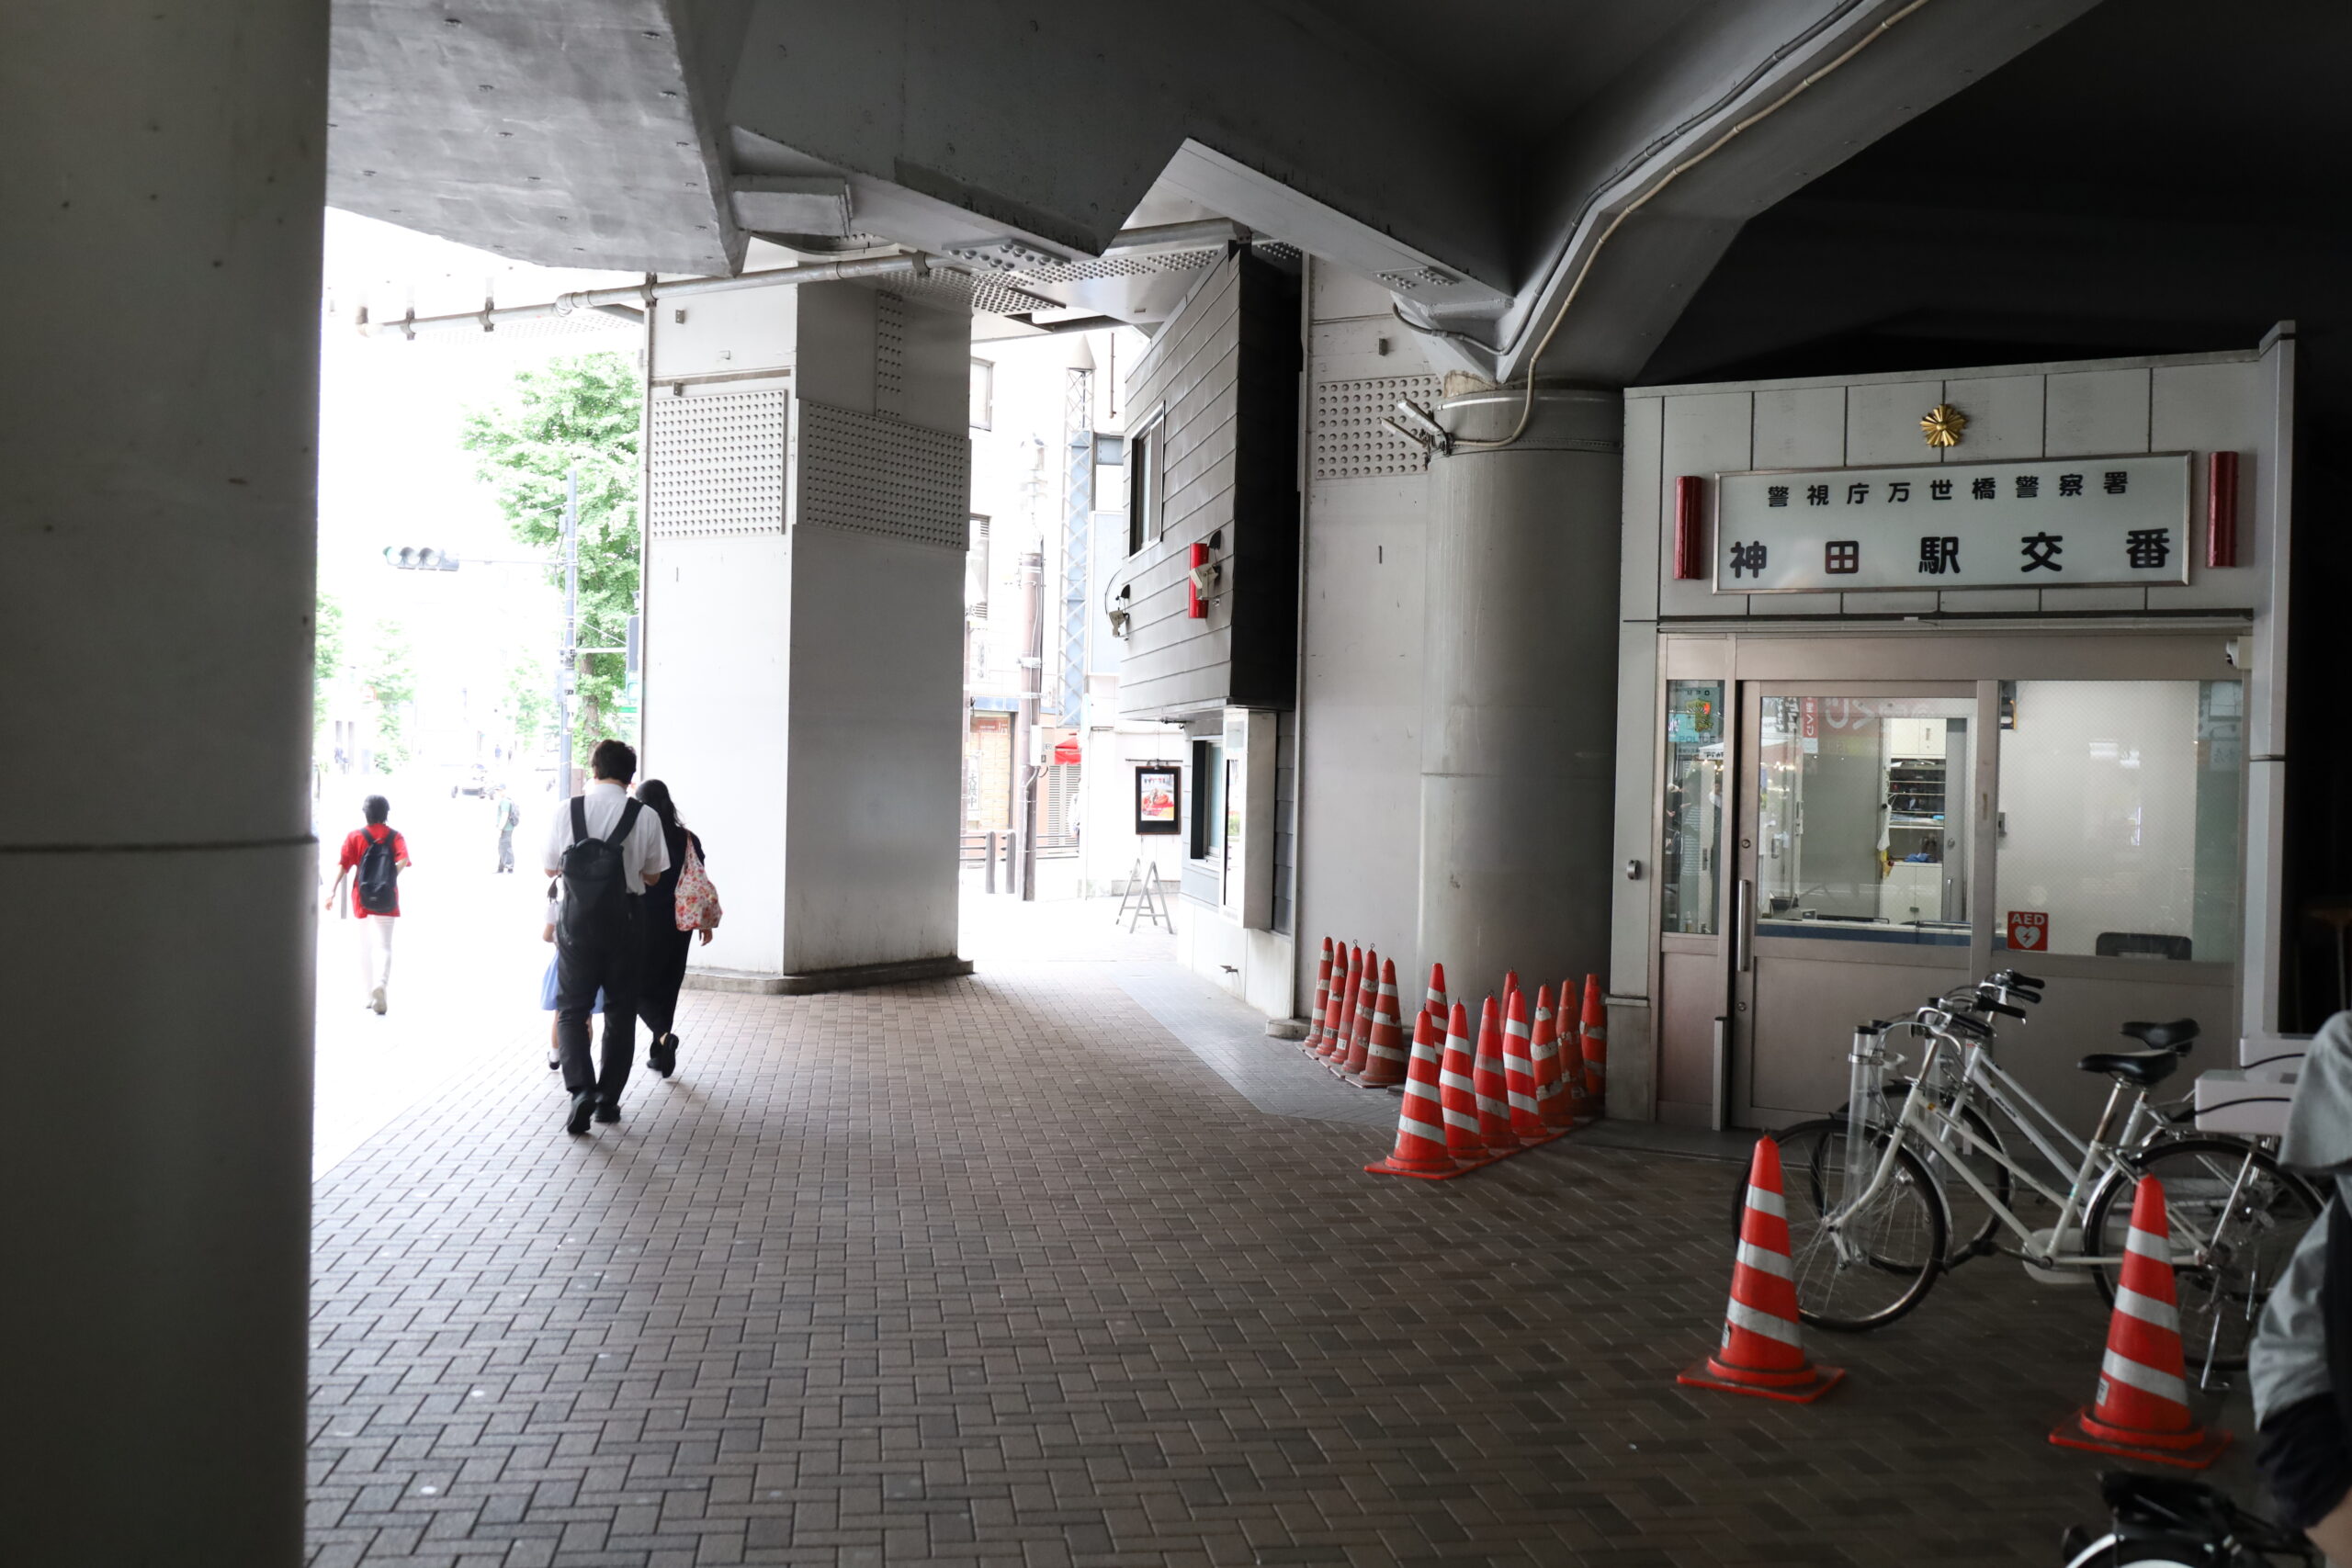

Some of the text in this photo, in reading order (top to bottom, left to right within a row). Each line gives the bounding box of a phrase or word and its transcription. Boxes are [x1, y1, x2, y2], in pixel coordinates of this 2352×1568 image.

[1768, 471, 2128, 507] 警視庁万世橋警察署
[1729, 528, 2170, 579] 神田駅交番
[2011, 914, 2044, 925] AED
